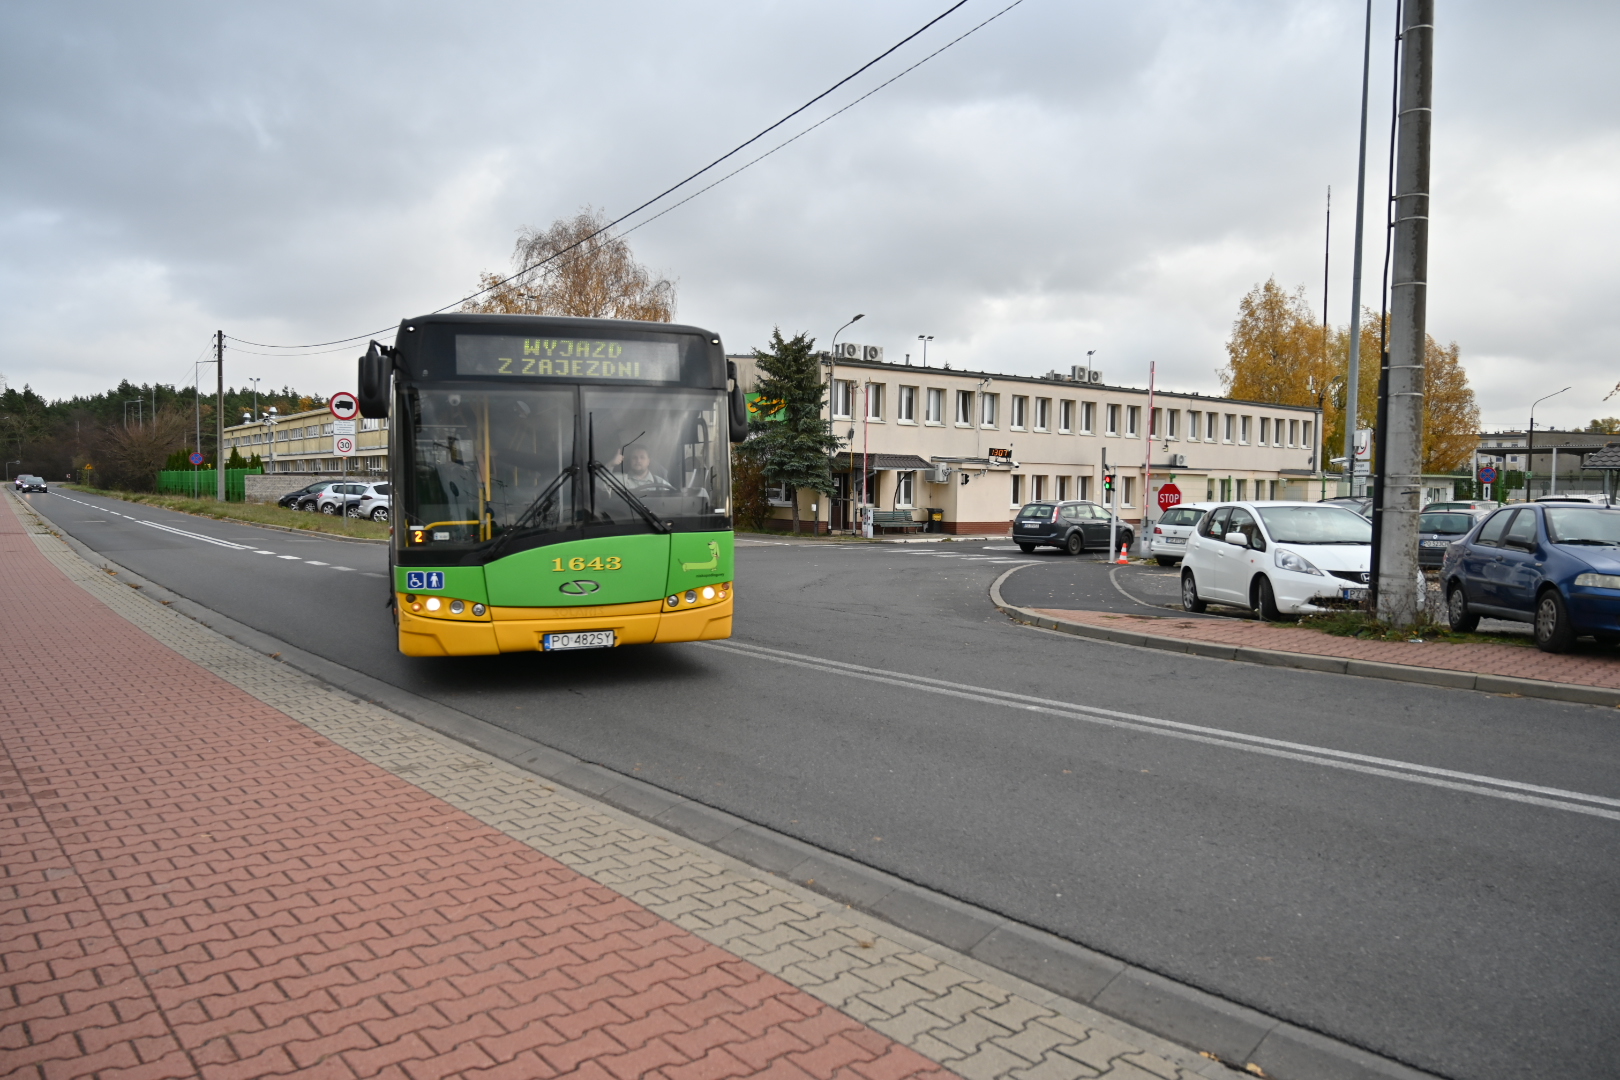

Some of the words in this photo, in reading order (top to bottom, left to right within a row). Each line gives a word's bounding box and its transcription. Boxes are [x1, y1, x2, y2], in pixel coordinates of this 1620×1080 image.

[523, 339, 622, 358] WYJAZD
[498, 357, 513, 374] Z
[522, 359, 640, 377] ZAJEZDNI
[340, 441, 350, 449] 30
[1159, 493, 1180, 504] STOP
[414, 530, 423, 543] 2
[551, 556, 623, 573] 1643
[551, 635, 570, 648] PO
[574, 632, 612, 646] 482SY
